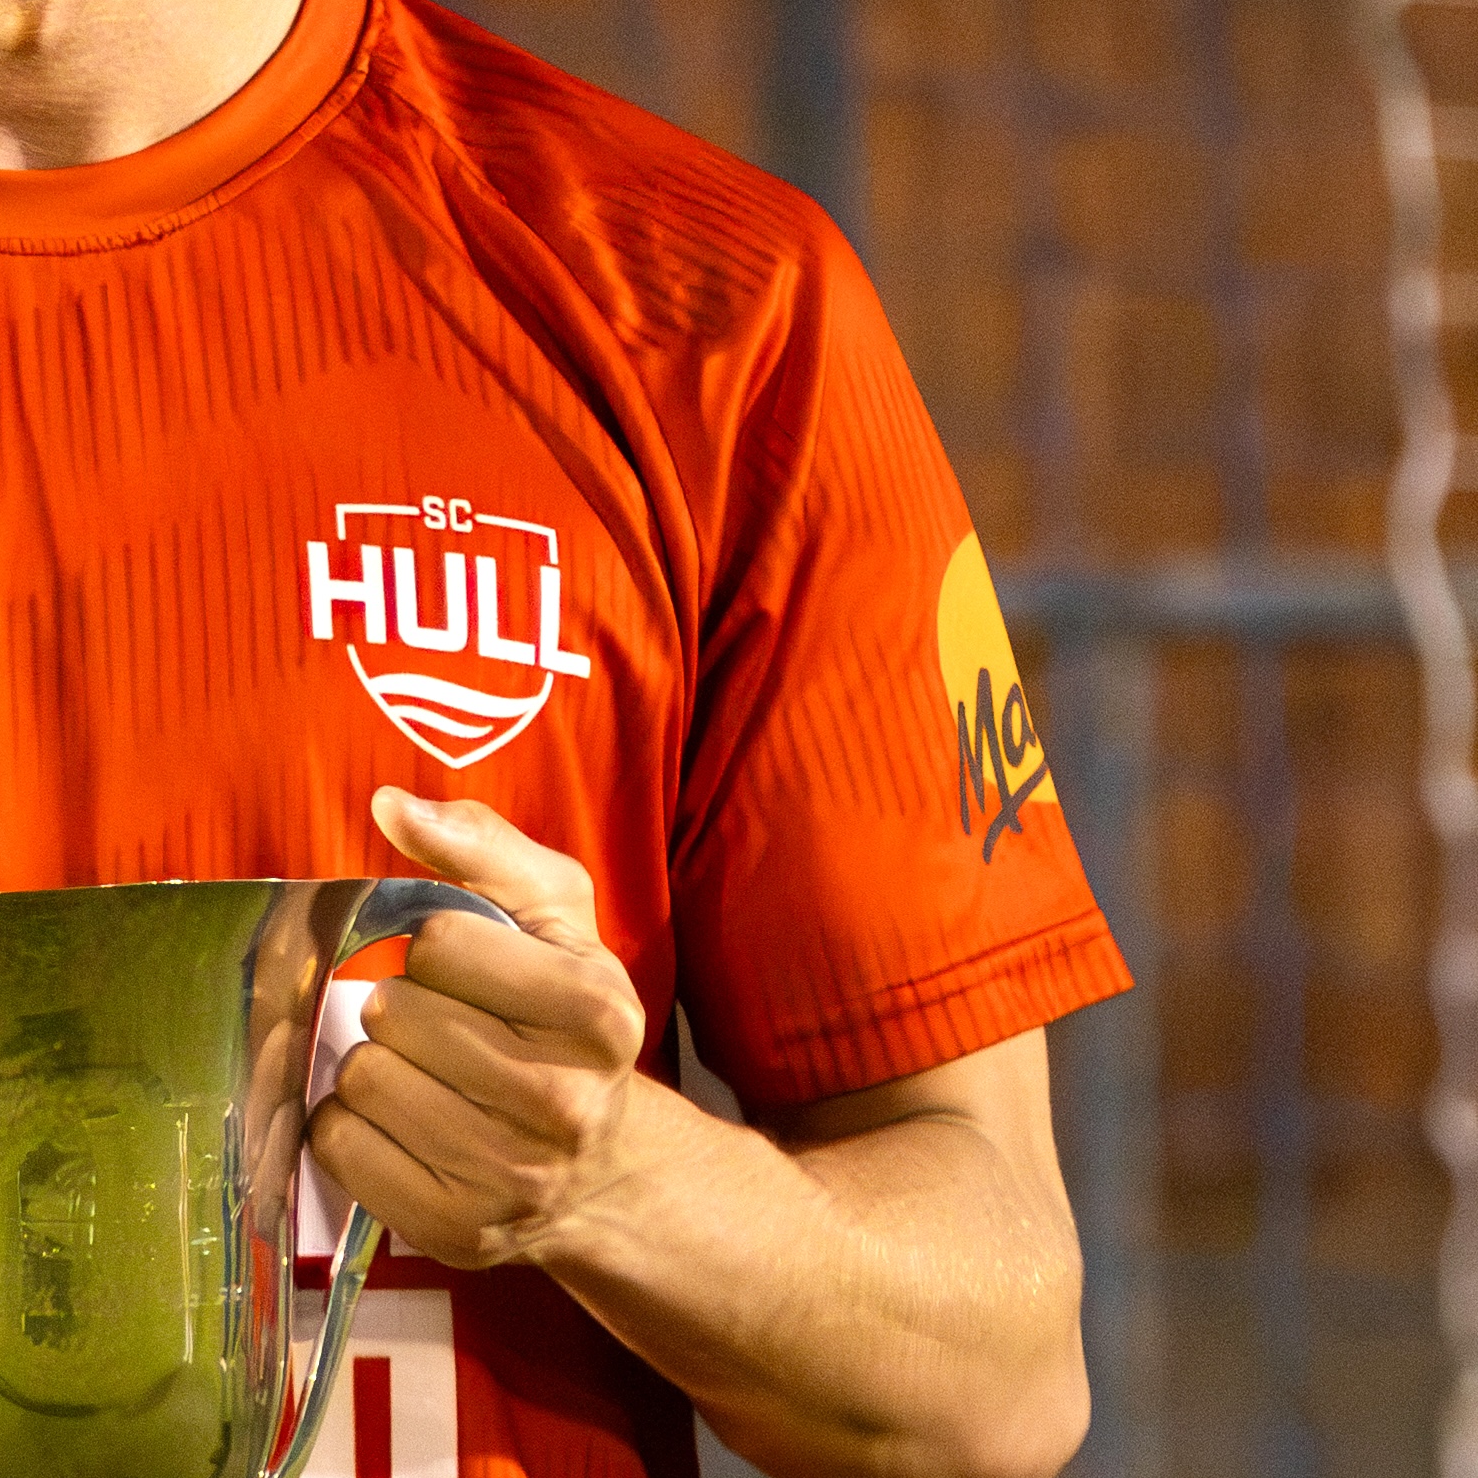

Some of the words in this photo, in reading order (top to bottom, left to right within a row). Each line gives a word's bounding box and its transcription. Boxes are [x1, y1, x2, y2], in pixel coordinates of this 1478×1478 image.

[422, 495, 473, 533] SC
[307, 540, 591, 679] HULL
[958, 667, 1039, 836] Ma
